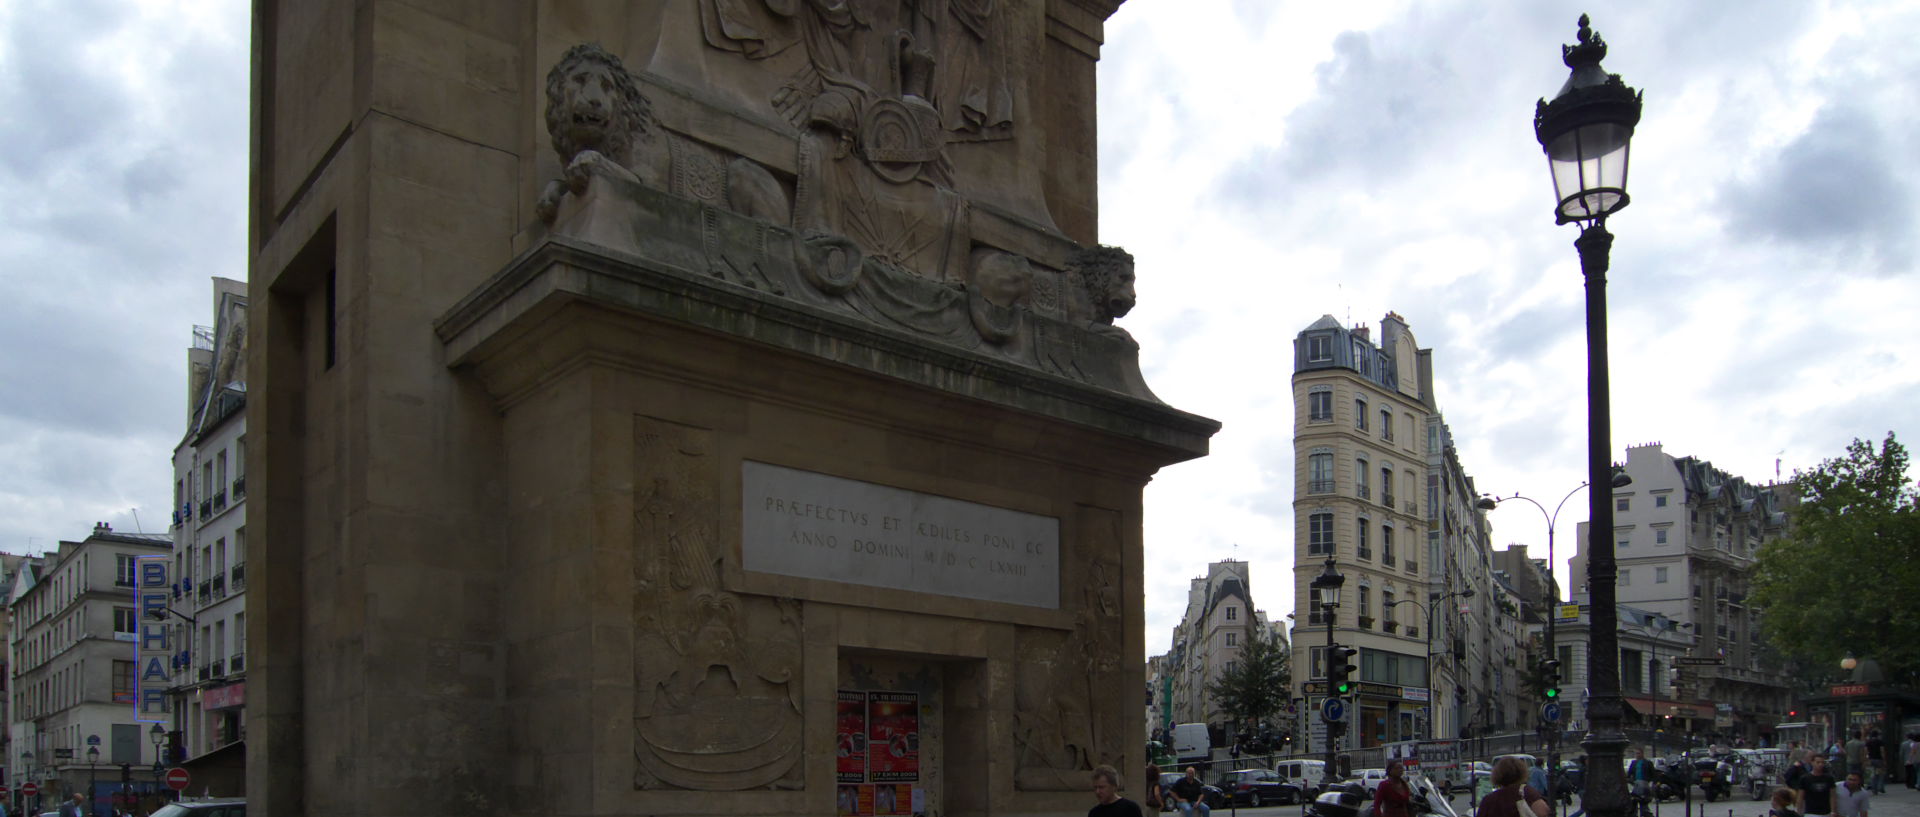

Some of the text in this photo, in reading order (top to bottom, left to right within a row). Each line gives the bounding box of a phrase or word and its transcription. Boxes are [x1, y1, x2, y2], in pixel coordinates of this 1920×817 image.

[790, 530, 838, 549] ANNO
[853, 539, 910, 560] DOMINI
[989, 559, 1027, 577] LXXIII
[883, 516, 902, 531] ET
[983, 534, 1016, 552] PONI
[143, 563, 167, 713] BEHAR
